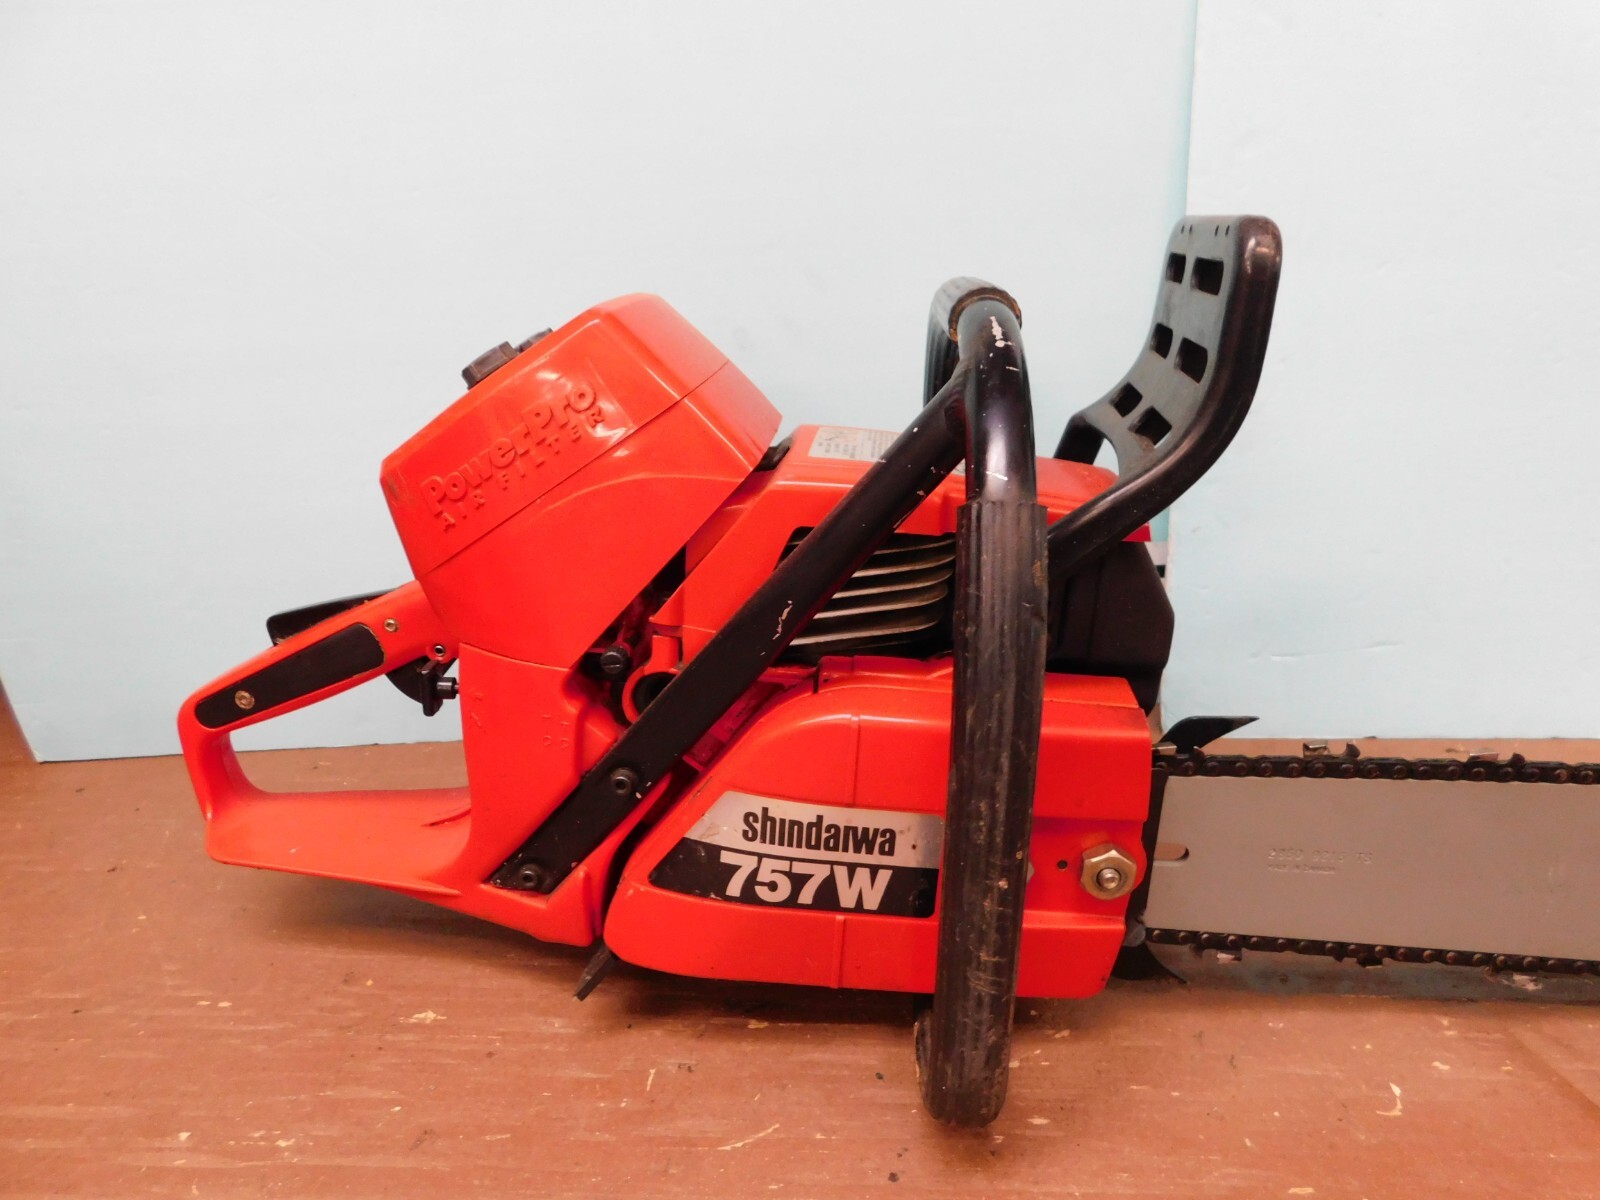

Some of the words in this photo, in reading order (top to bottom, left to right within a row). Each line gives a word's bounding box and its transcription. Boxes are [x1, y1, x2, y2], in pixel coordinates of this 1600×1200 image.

[440, 489, 486, 533] AIR
[496, 407, 605, 492] FILTER
[742, 806, 897, 857] shindaiwa
[720, 850, 893, 911] 757W
